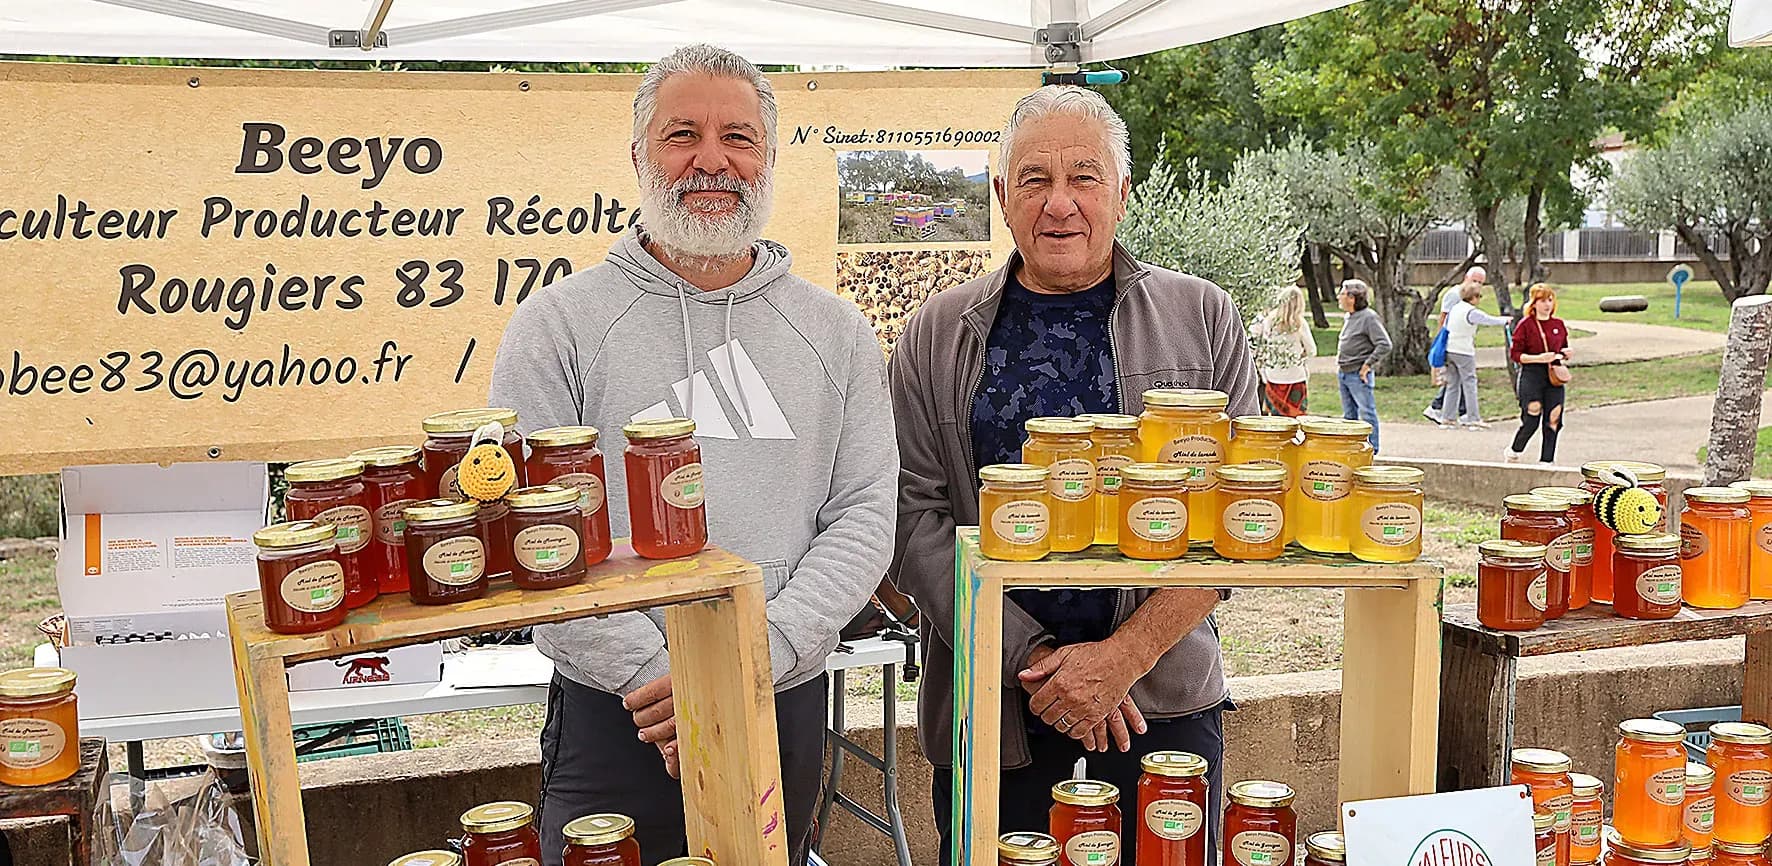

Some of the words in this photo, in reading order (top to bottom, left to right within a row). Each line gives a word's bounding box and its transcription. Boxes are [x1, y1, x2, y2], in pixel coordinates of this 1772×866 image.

[234, 122, 443, 189] Beeyo
[790, 126, 819, 145] N°
[200, 195, 465, 239] Producteur
[116, 264, 365, 332] Rougiers
[394, 259, 465, 309] 83
[0, 340, 413, 402] bee83@yahoo.fr
[1418, 838, 1486, 866] ALEURS
